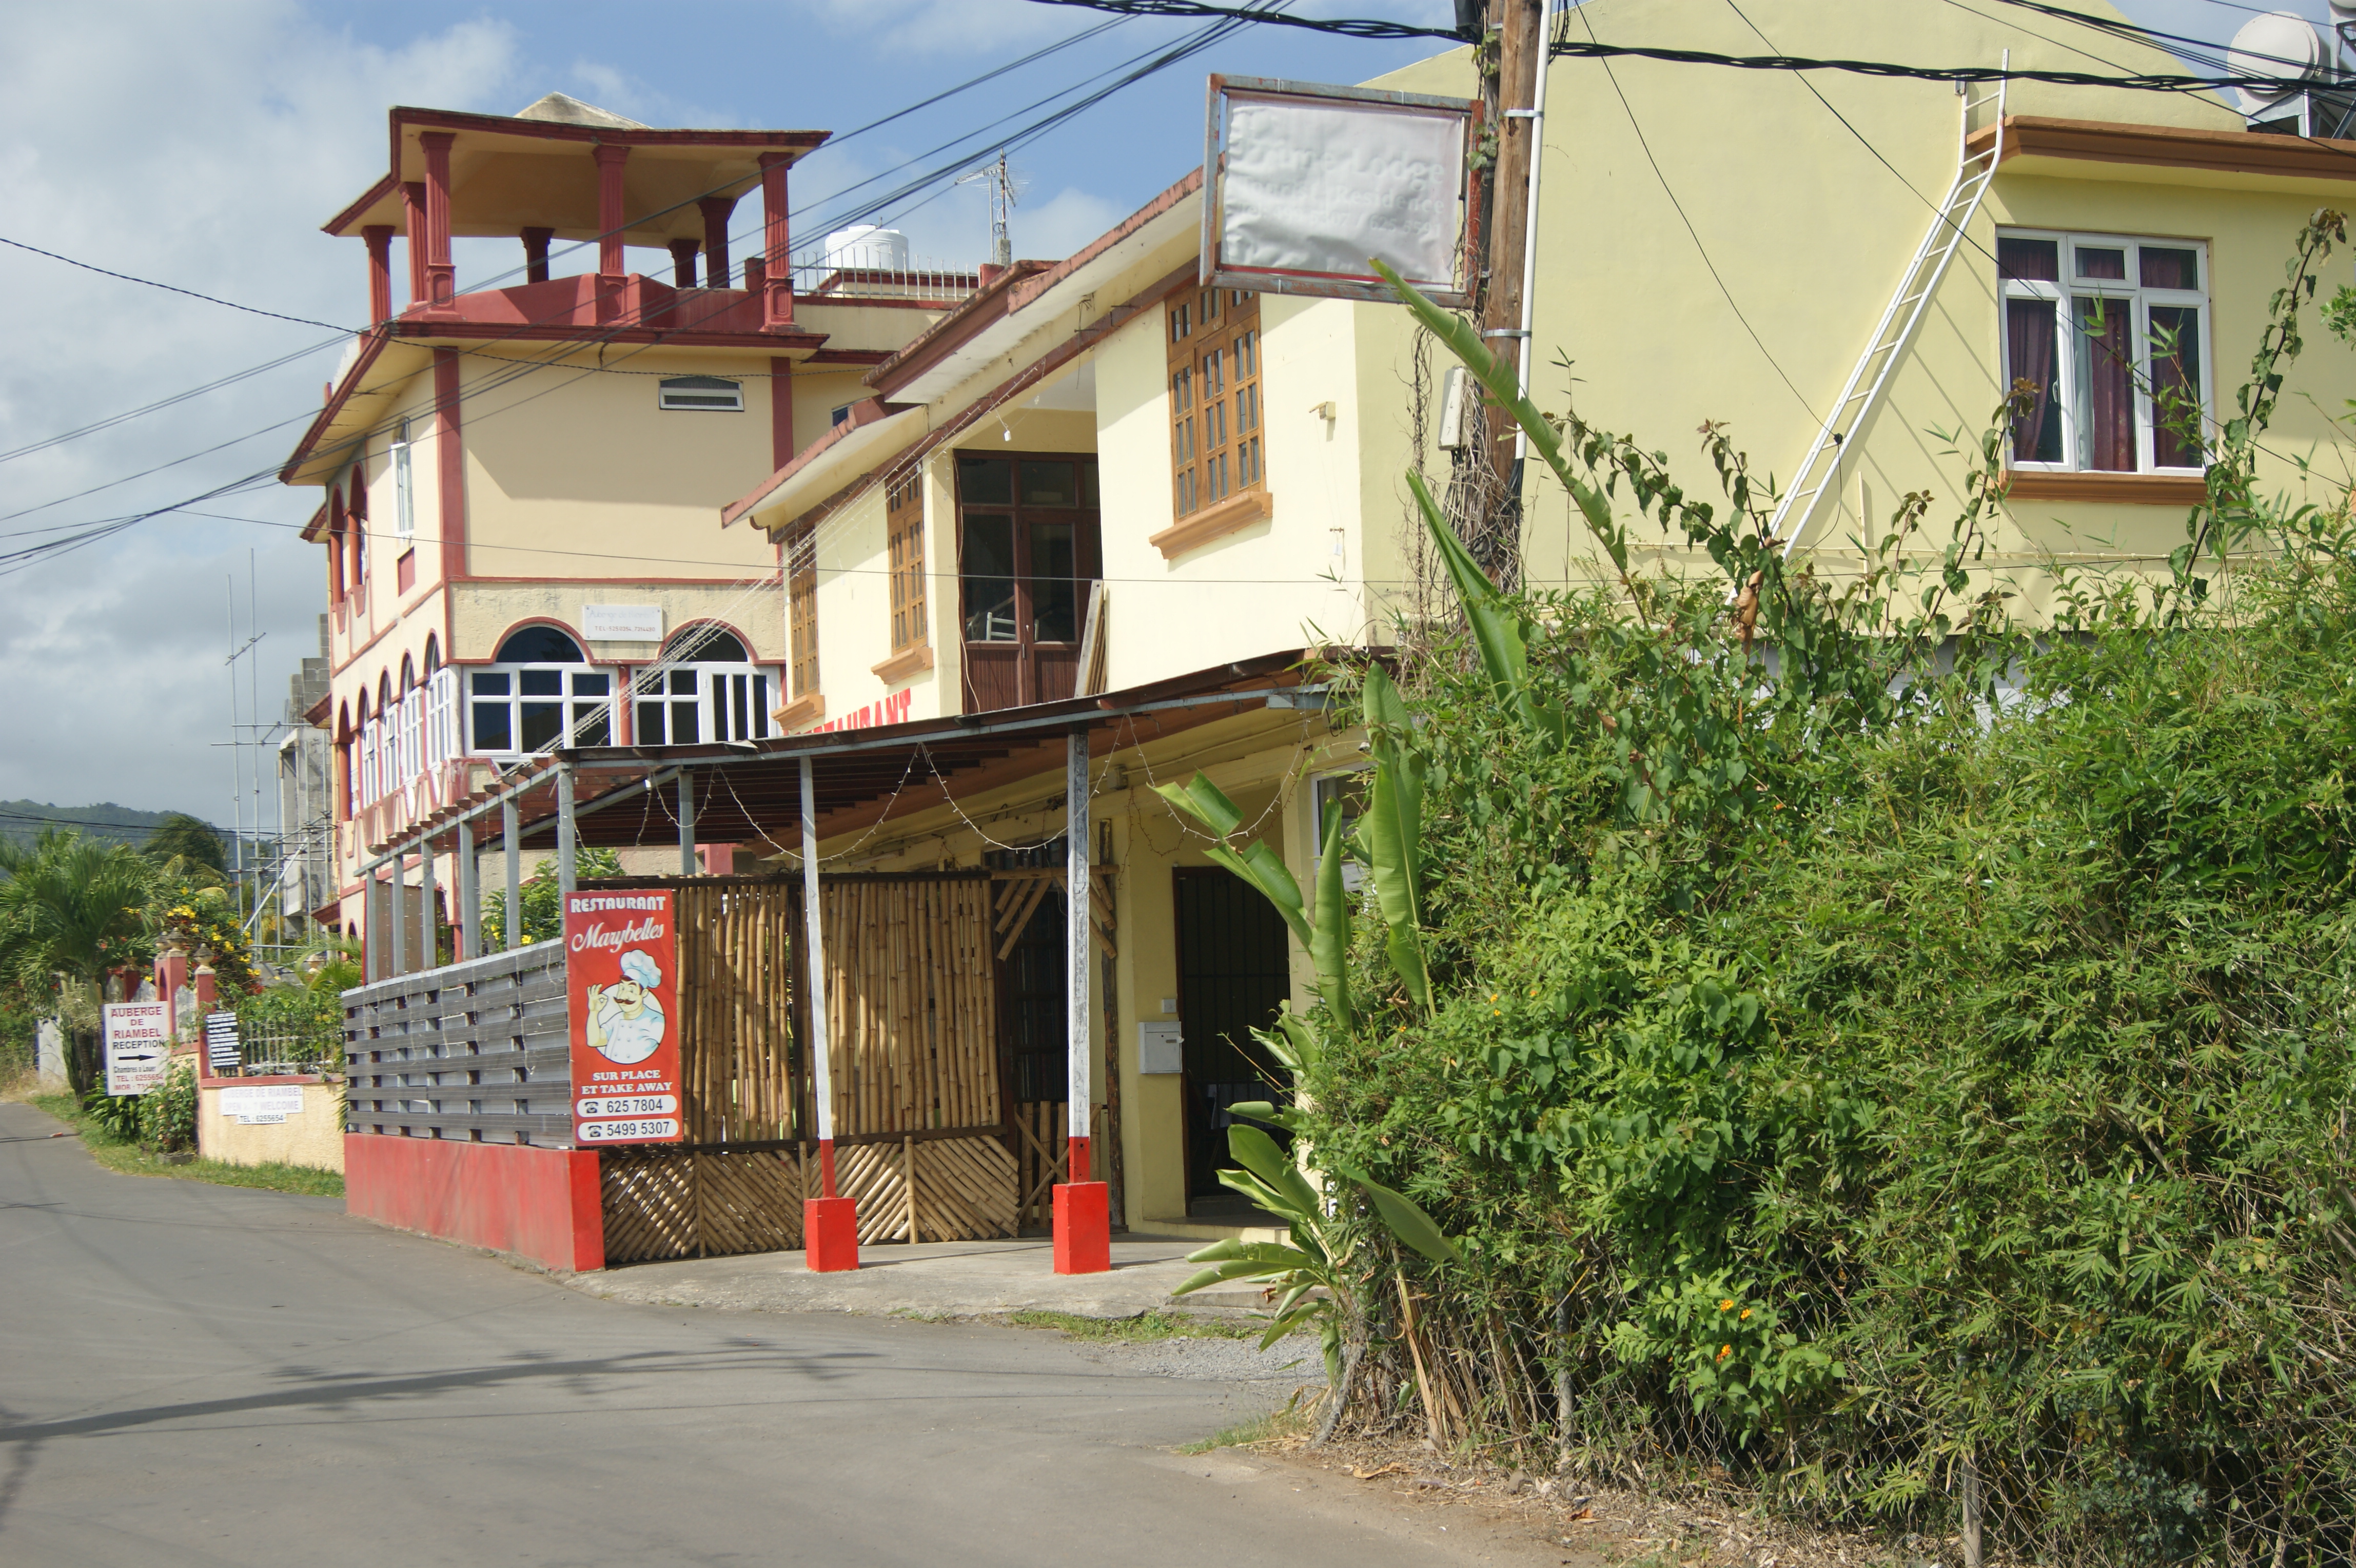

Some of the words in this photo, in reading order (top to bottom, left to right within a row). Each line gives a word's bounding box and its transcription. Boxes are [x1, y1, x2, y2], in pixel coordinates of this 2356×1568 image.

[1334, 185, 1445, 214] Residence
[571, 896, 666, 913] RESTAURANT
[571, 917, 664, 953] Marybelles
[111, 1007, 162, 1017] AUBERGE
[114, 1028, 162, 1039] RIAMBEL
[113, 1040, 164, 1050] RECEPTION
[593, 1071, 619, 1081] SUR
[620, 1070, 661, 1080] PLACE
[257, 1088, 265, 1097] DE
[268, 1087, 303, 1097] RIAMBEL
[581, 1085, 598, 1094] ET
[600, 1084, 634, 1093] TAKE
[636, 1082, 673, 1092] AWAY
[260, 1101, 299, 1110] WELCOME
[607, 1100, 629, 1113] 625
[633, 1099, 663, 1111] 7804
[607, 1123, 636, 1136] 5499
[641, 1121, 670, 1134] 5307
